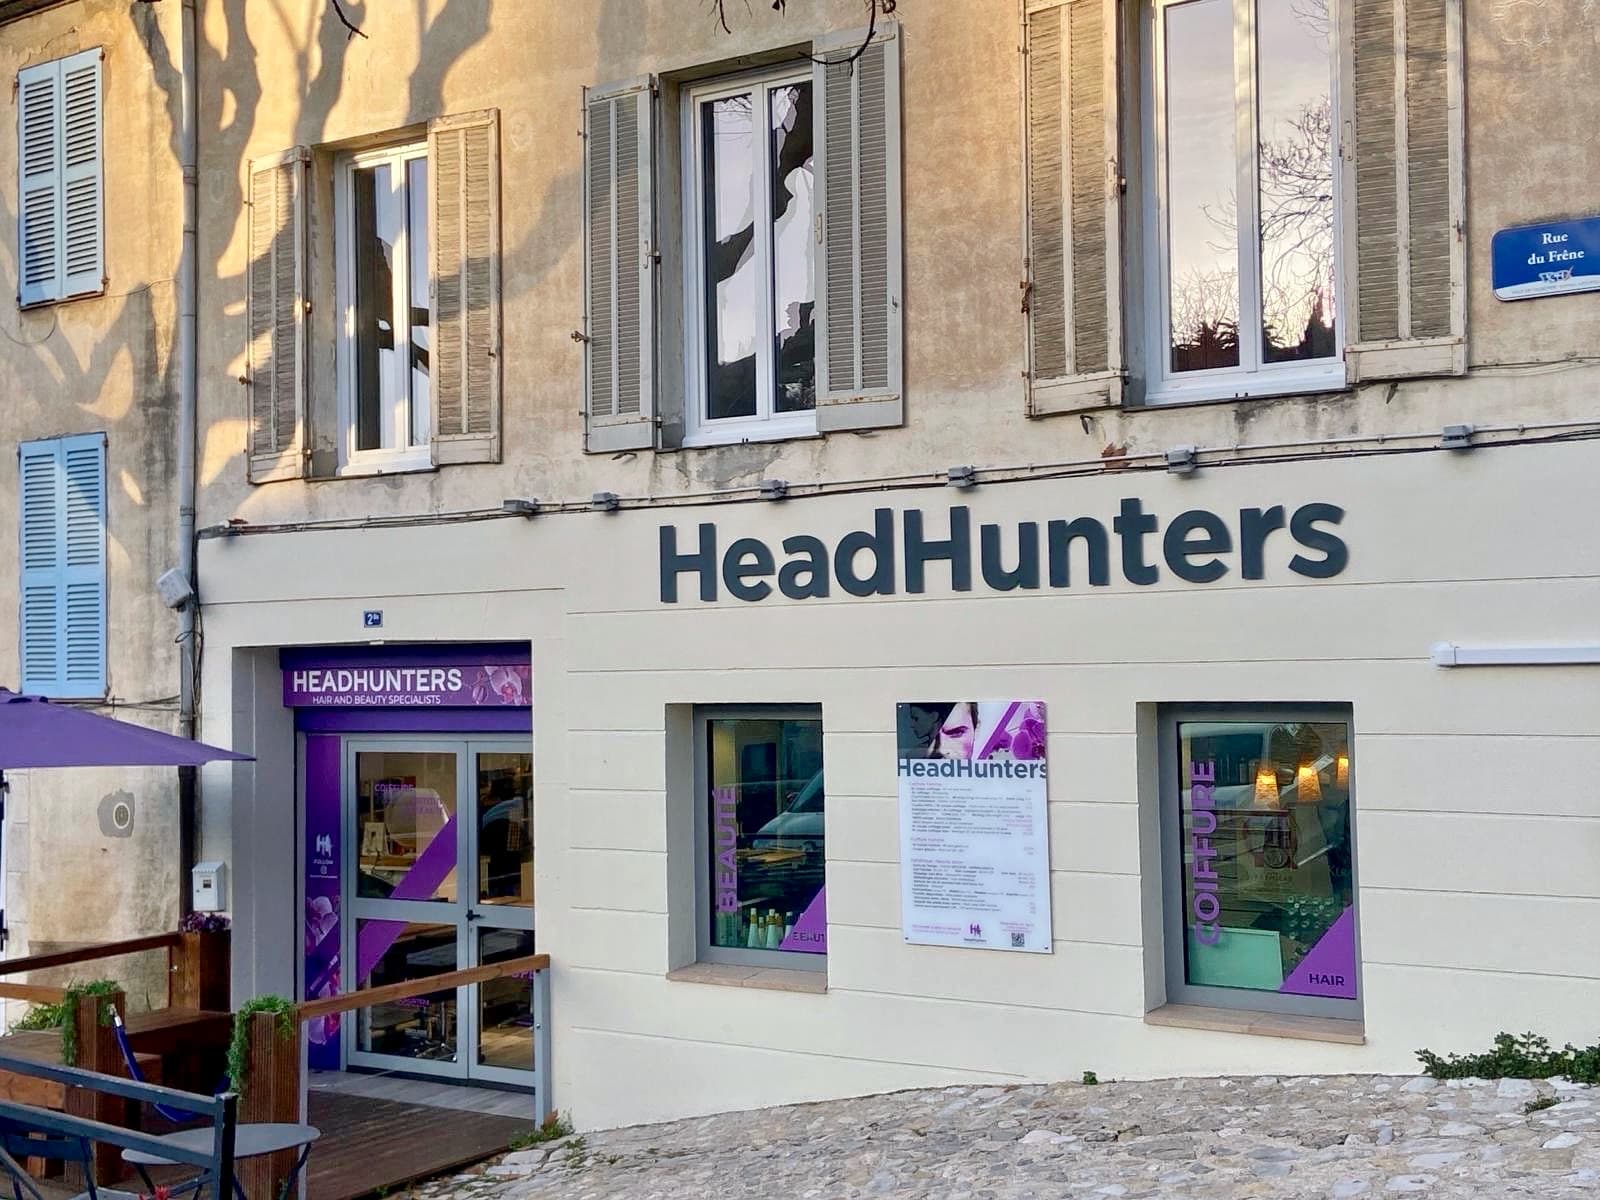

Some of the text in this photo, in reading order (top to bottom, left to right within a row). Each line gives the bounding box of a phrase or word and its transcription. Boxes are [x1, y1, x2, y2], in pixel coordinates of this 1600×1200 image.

[1542, 232, 1568, 244] Rue
[1527, 249, 1585, 265] du Frêne
[659, 497, 1349, 603] HeadHunters
[293, 668, 462, 692] HEADHUNTERS
[312, 694, 441, 704] HAIR AND BEAUTY SPECIALISTS
[712, 786, 738, 913] BEAUTÉ
[1190, 761, 1220, 946] COIFFURE
[1309, 973, 1345, 986] HAIR
